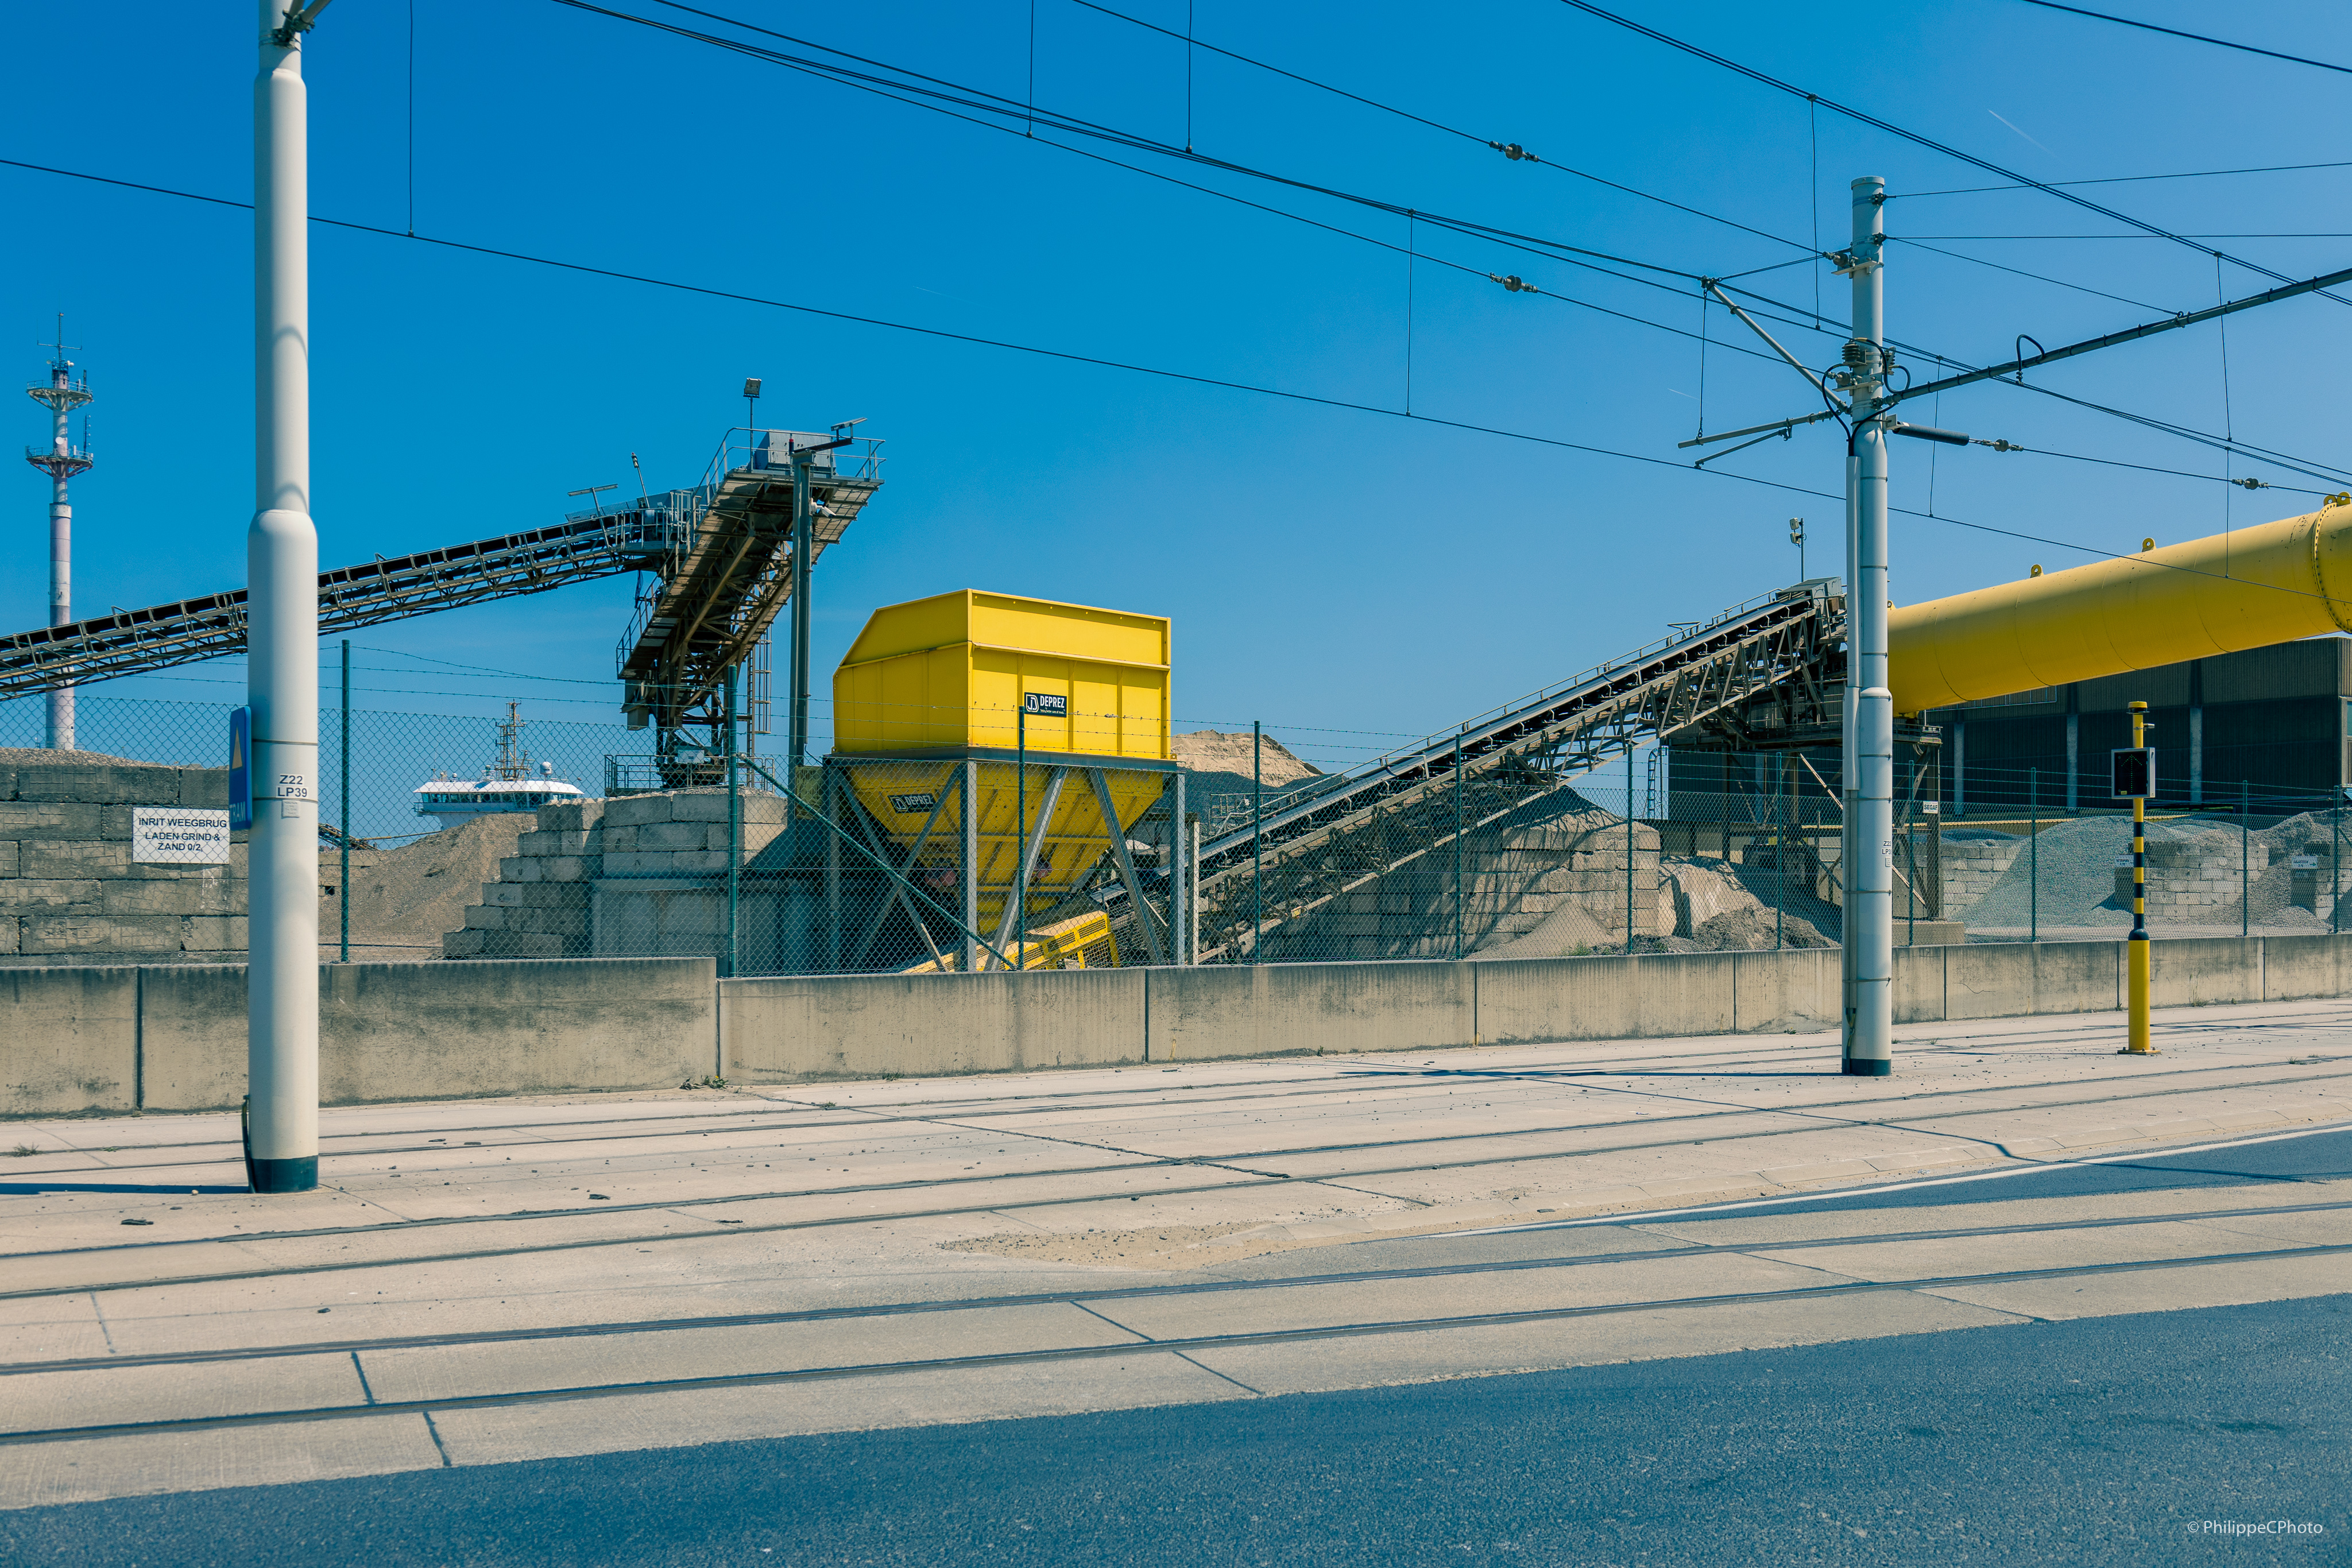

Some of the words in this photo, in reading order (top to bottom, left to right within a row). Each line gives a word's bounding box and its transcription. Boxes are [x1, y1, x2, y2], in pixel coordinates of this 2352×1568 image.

[1040, 695, 1065, 708] DEPREZ
[279, 775, 303, 785] Z22
[277, 787, 307, 797] LP39
[904, 795, 933, 805] DEPREZ
[229, 801, 246, 823] TRAM
[138, 818, 165, 826] INRIT
[167, 818, 227, 827] WEEGBRUG
[145, 832, 179, 840] LADEN
[181, 833, 211, 841] GRIND
[157, 842, 185, 850] ZAND
